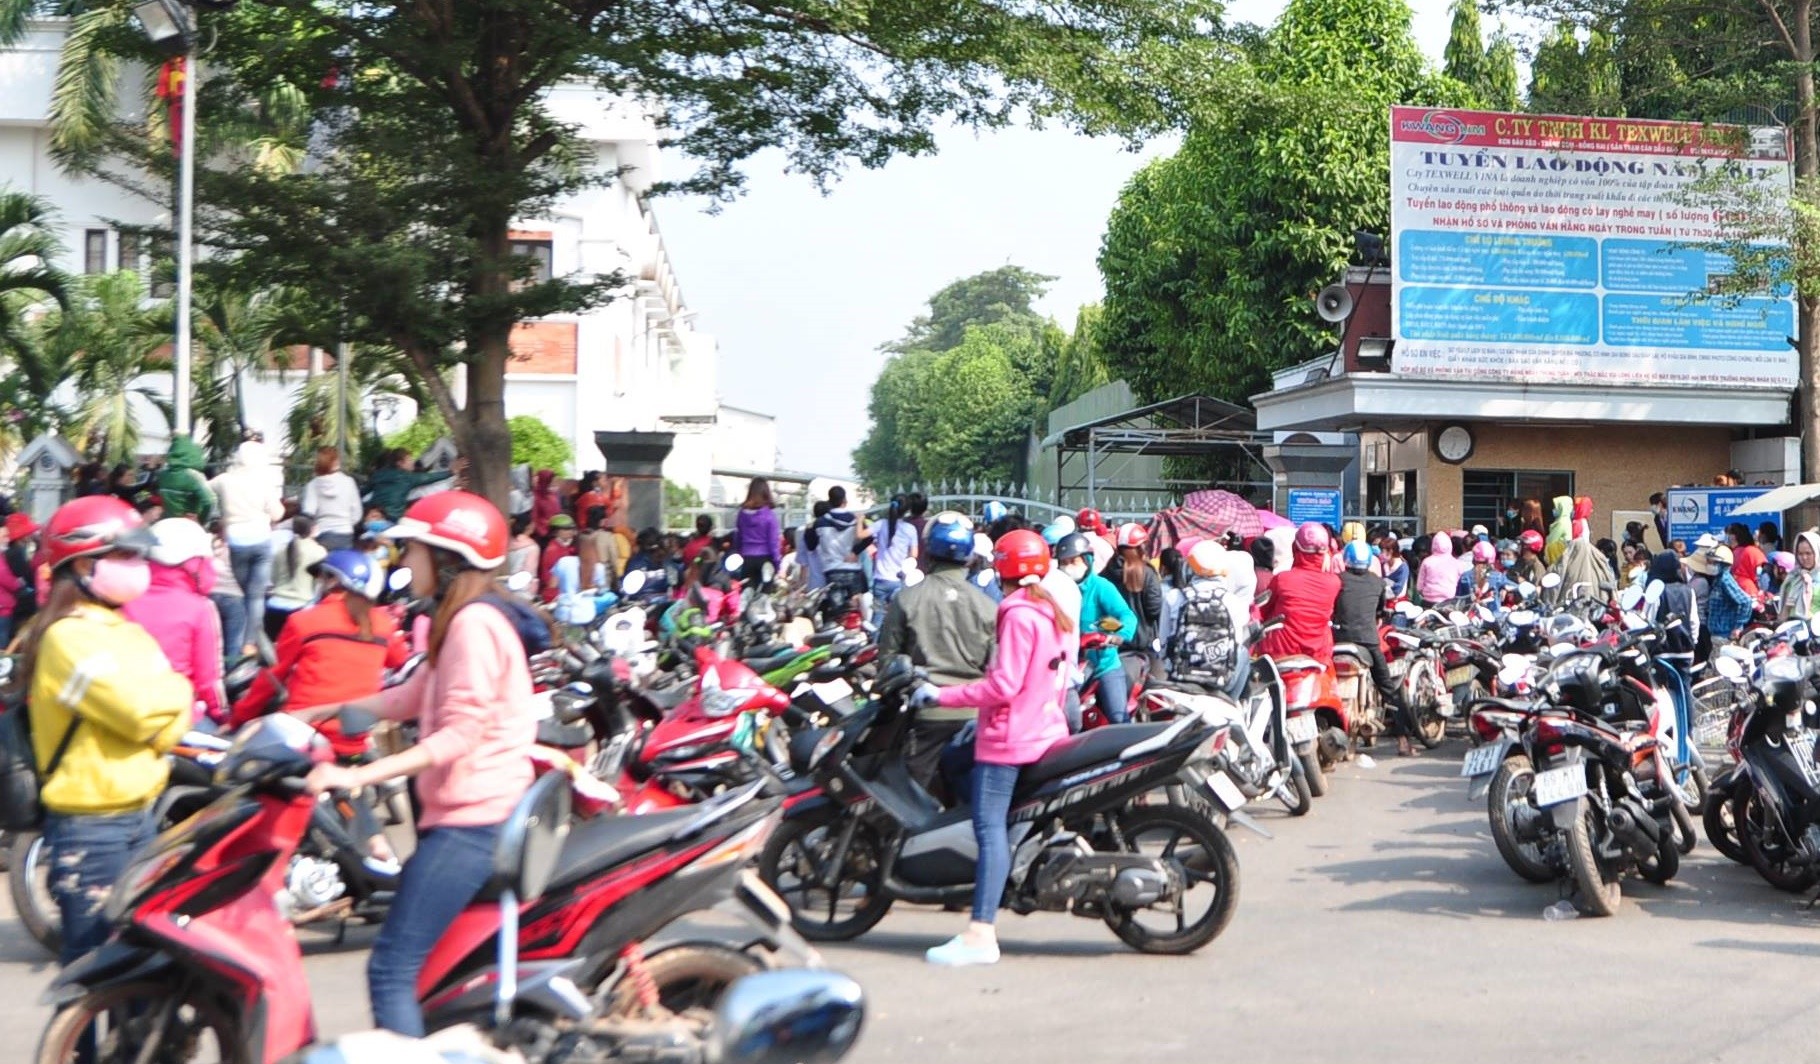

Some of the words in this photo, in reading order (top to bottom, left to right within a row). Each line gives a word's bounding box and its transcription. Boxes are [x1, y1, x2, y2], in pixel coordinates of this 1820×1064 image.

[1495, 117, 1532, 137] C.TY
[1538, 119, 1584, 140] TNHH
[1589, 122, 1611, 141] KL
[1420, 148, 1507, 169] TUYỂN
[1516, 156, 1568, 172] LAO
[1576, 156, 1644, 176] ĐỘNG
[1407, 182, 1439, 194] Chuyên
[1475, 171, 1498, 182] VINA
[1510, 174, 1536, 183] doanh
[1538, 175, 1567, 187] nghiệp
[1407, 195, 1436, 210] Tuyển
[1438, 199, 1452, 209] lao
[1455, 200, 1477, 213] động
[1480, 199, 1497, 212] phổ
[1499, 200, 1526, 214] thông
[1528, 203, 1539, 213] và
[1541, 204, 1555, 214] lao
[1557, 204, 1580, 217] động
[1612, 206, 1634, 219] nghề
[1636, 209, 1656, 221] may
[1665, 208, 1678, 220] số
[1681, 211, 1710, 223] lượng
[1461, 215, 1474, 227] HỒ
[1476, 218, 1489, 228] SƠ
[1491, 218, 1504, 228] VÀ
[1560, 219, 1586, 232] HÀNG
[1588, 221, 1613, 233] NGÀY
[1615, 224, 1646, 235] TRONG
[1648, 223, 1672, 236] TUẦN
